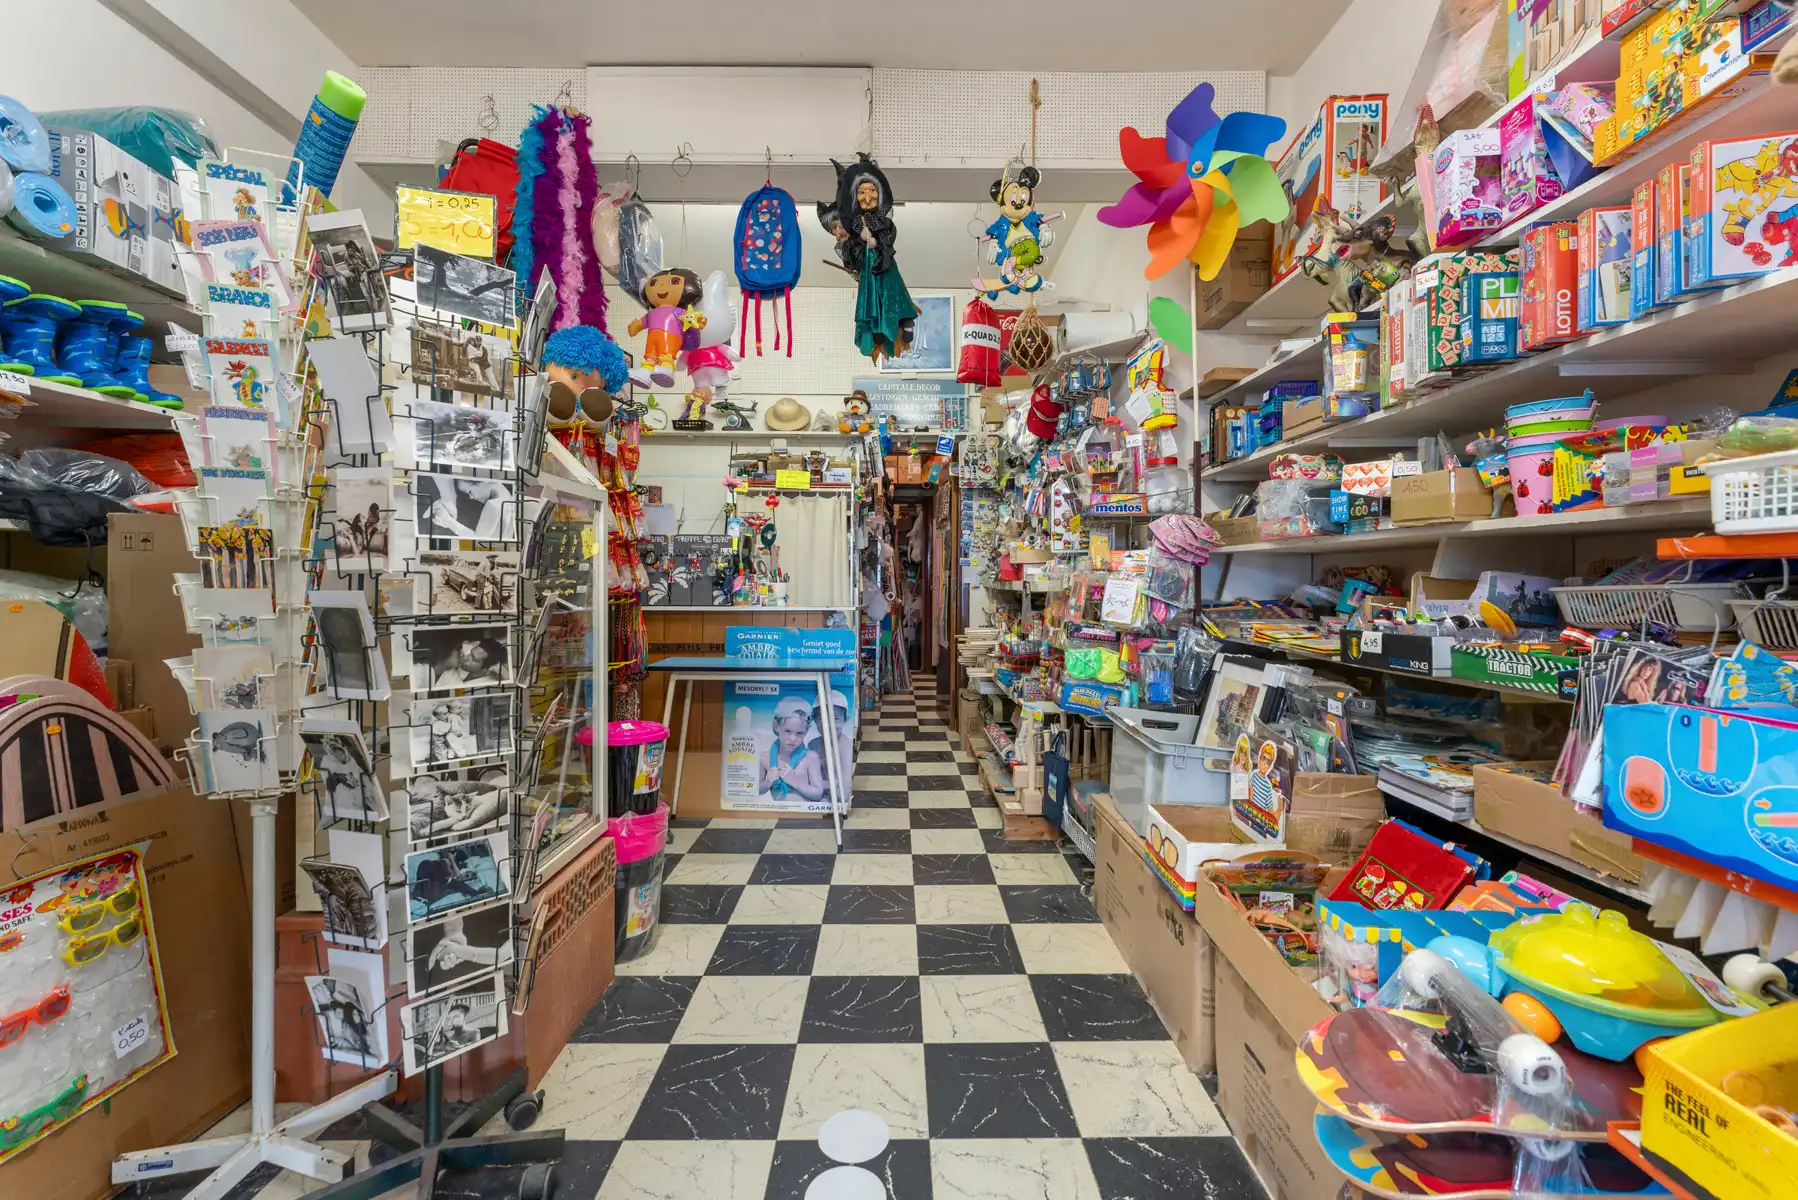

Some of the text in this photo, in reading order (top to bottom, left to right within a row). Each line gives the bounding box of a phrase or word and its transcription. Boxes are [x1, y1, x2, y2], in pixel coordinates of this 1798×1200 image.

[1336, 103, 1380, 119] pony
[1298, 116, 1323, 161] pony
[48, 129, 61, 178] JUNIOR
[448, 197, 480, 210] 0,25
[207, 285, 271, 309] BRAVO!
[1556, 289, 1572, 335] LOTTO
[1481, 325, 1506, 334] ABC
[1481, 334, 1506, 343] 123
[205, 339, 270, 357] SILENCE!
[1397, 465, 1418, 474] 0,50
[1402, 479, 1429, 493] 1,50
[1331, 495, 1347, 505] SHOW
[1095, 503, 1142, 513] mentos
[1331, 504, 1347, 514] TIME
[741, 642, 776, 653] AMBRE
[787, 646, 822, 655] beschermd
[803, 639, 841, 648] Geniet goed
[1487, 659, 1533, 678] TRACTOR
[118, 1028, 145, 1049] 0,50
[1665, 1080, 1731, 1130] THE FEEL OF
[1664, 1092, 1710, 1138] REAL
[1663, 1111, 1739, 1174] ENGINEERING
